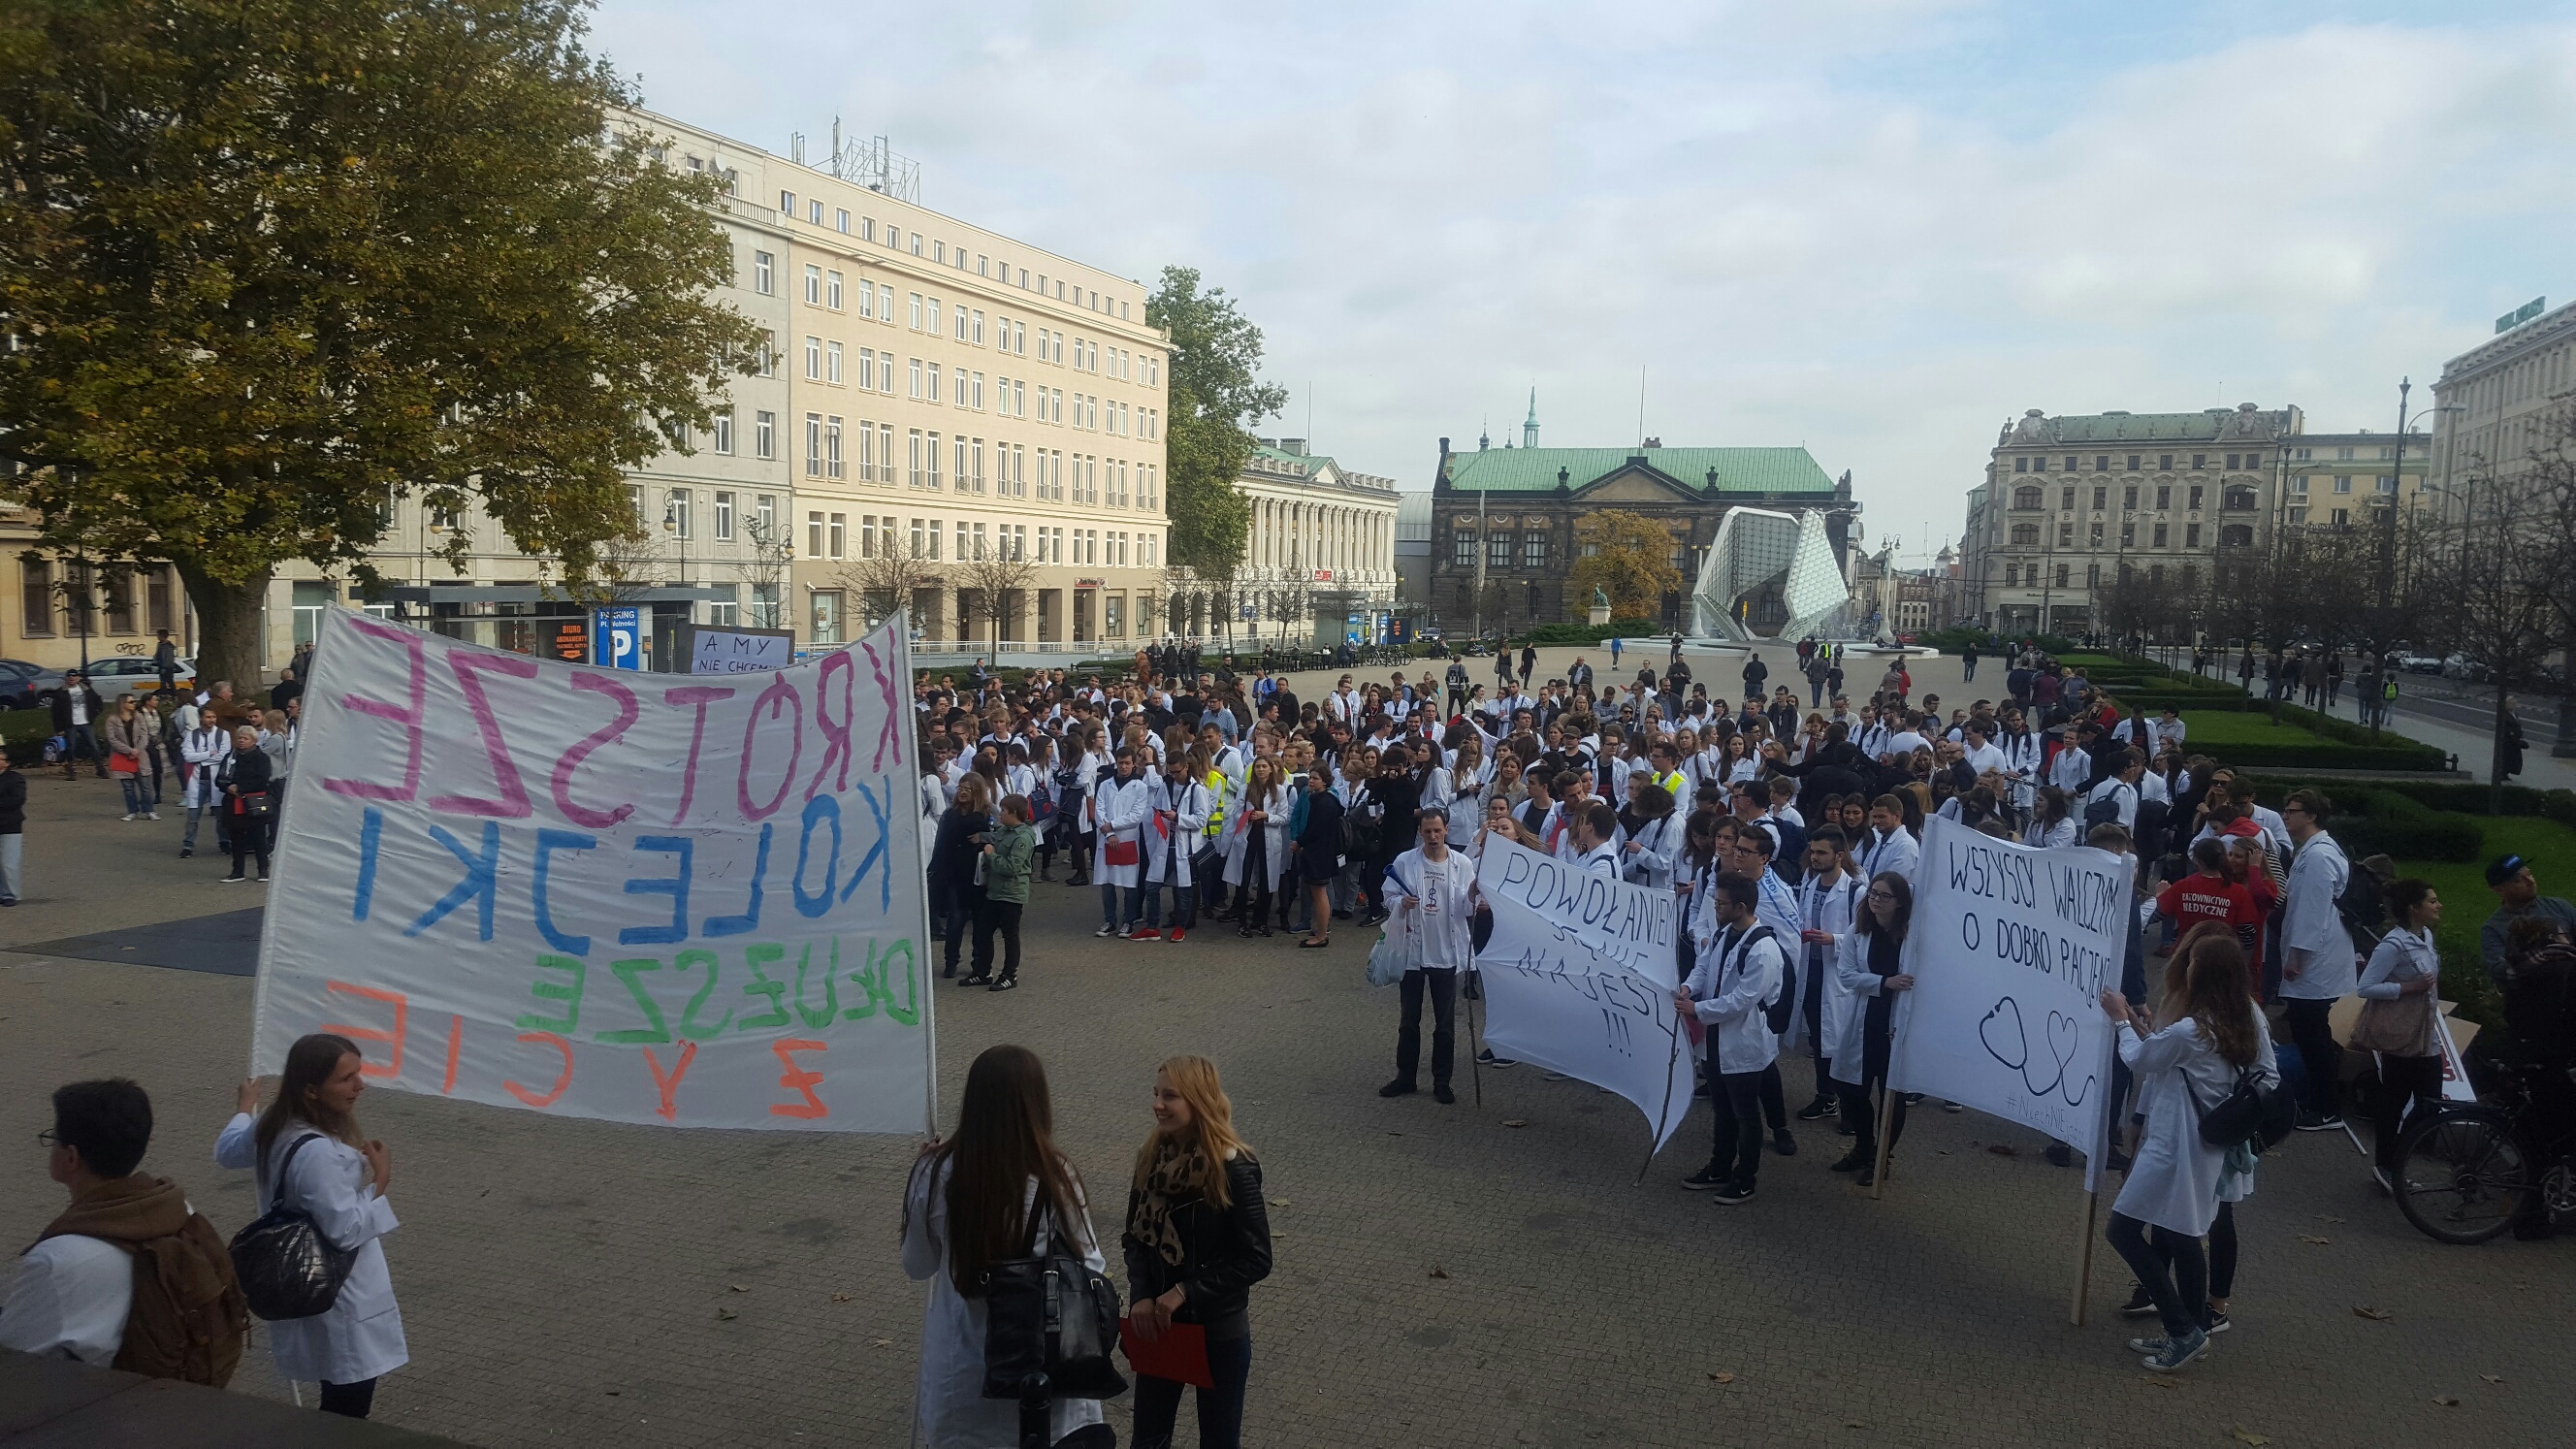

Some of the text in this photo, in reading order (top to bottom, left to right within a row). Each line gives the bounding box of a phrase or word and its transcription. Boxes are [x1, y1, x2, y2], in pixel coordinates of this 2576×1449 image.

[563, 625, 582, 634] BIURO
[704, 634, 770, 656] A MY
[698, 660, 777, 672] NIE CHCEM
[1948, 841, 2037, 909] WSZYSCY
[1497, 851, 1676, 949] POWOŁANIEM
[1962, 912, 1980, 950] O
[1996, 918, 2051, 974] DOBRO
